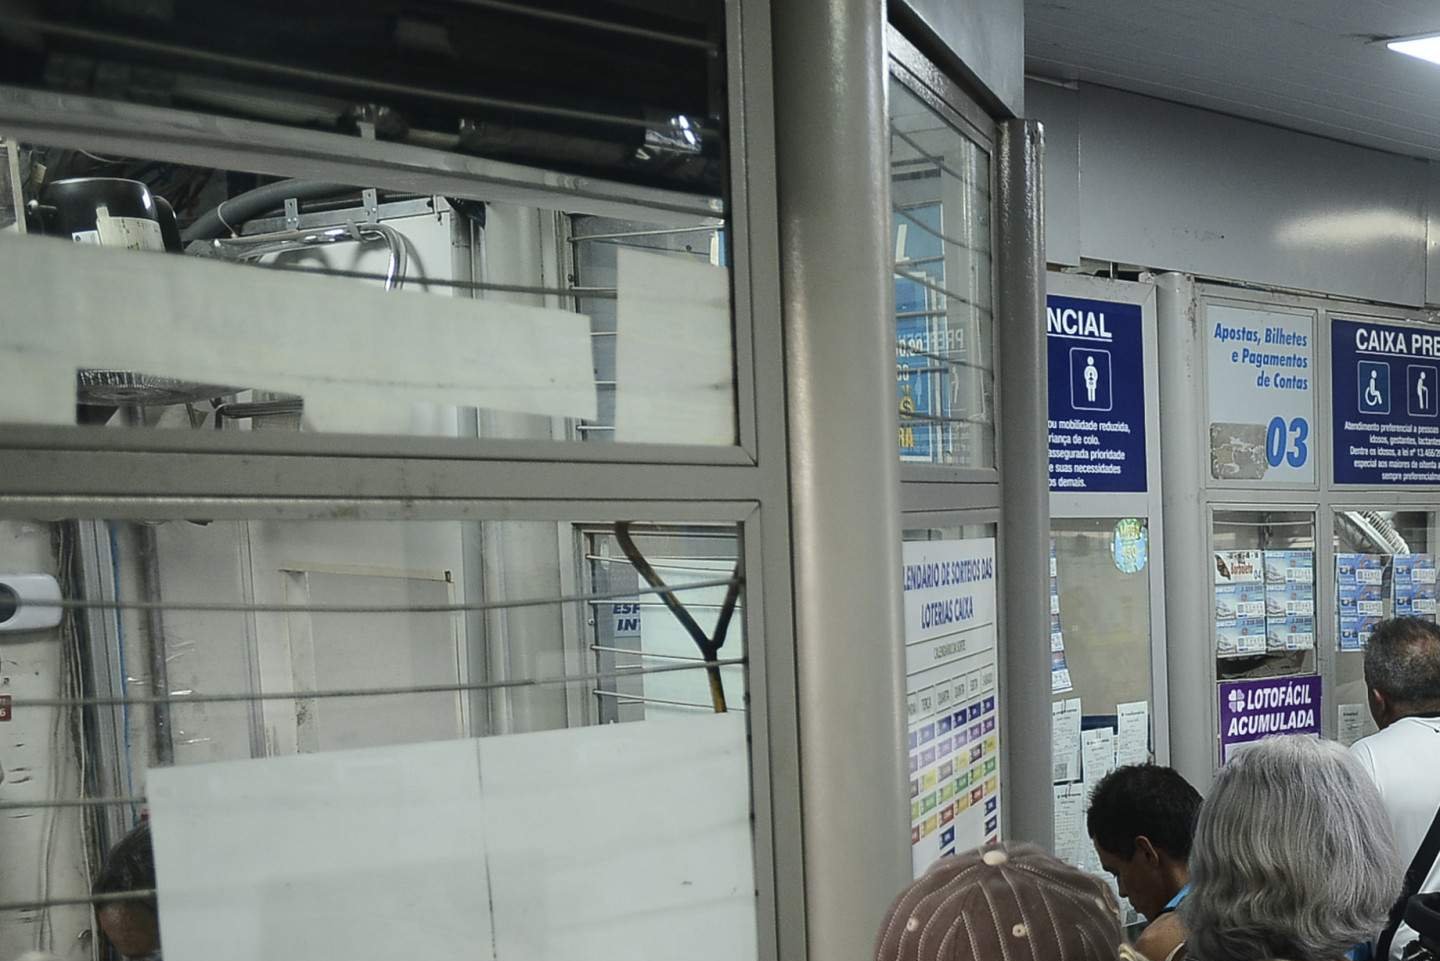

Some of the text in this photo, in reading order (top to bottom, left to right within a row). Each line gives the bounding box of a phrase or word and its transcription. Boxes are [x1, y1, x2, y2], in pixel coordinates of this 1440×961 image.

[1214, 323, 1307, 347] Apostas, Bilhetes
[1356, 328, 1408, 354] CAIXA
[1231, 348, 1308, 368] e Pagamentos
[1257, 370, 1308, 390] de Contas
[1058, 419, 1098, 431] mobilidade
[1072, 434, 1082, 444] de
[1266, 416, 1309, 468] 03
[1090, 449, 1125, 461] prioridade
[1055, 464, 1073, 473] suas
[941, 561, 950, 586] DE
[951, 558, 981, 585] SORTEIOS
[981, 556, 993, 580] DAS
[921, 596, 974, 630] LOTERIAS CAIXA
[1246, 681, 1312, 710] LOTOFÁCIL
[1227, 708, 1315, 737] ACUMULADA
